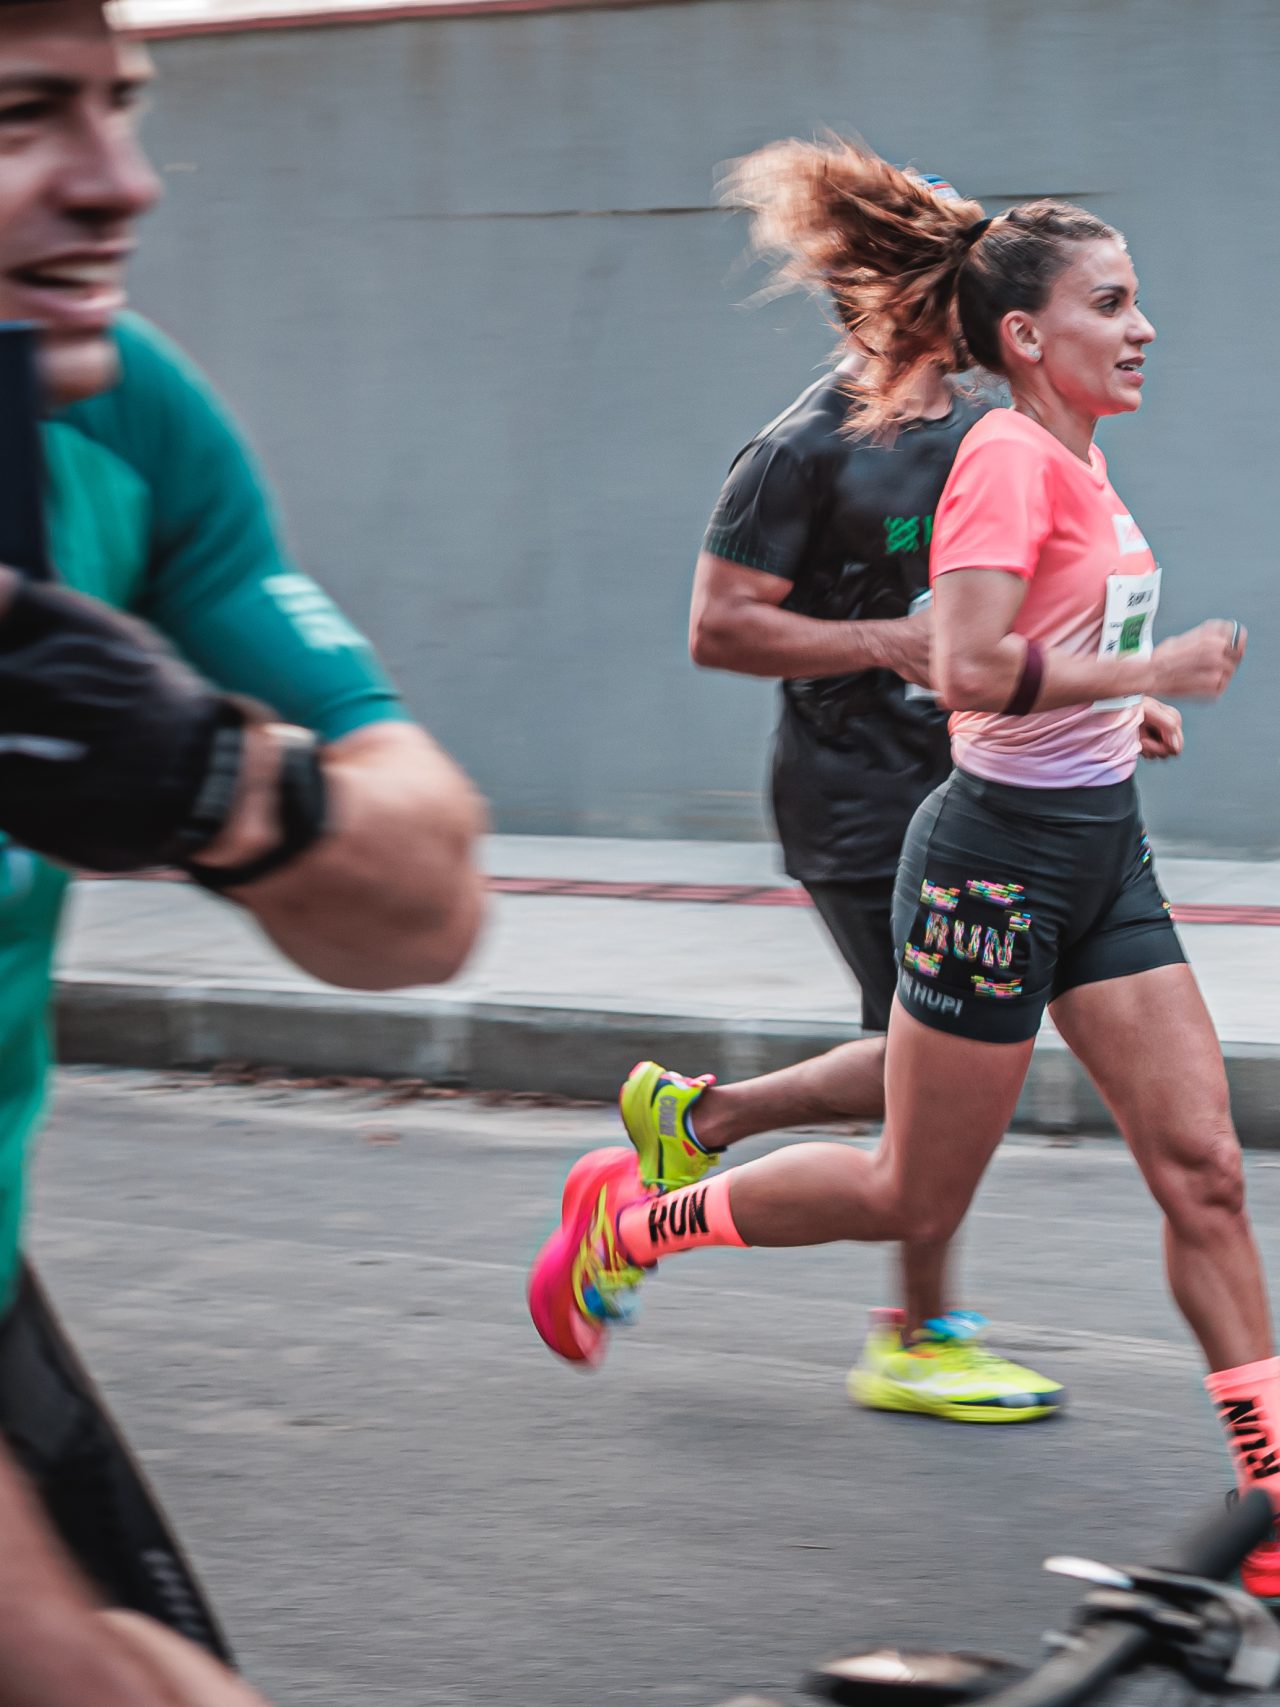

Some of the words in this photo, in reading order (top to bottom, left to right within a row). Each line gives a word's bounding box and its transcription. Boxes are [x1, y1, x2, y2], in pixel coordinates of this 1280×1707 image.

[924, 911, 1016, 969] RUN
[914, 981, 963, 1018] HUPI
[648, 1186, 711, 1243] RUN
[1217, 1400, 1280, 1479] RUN
